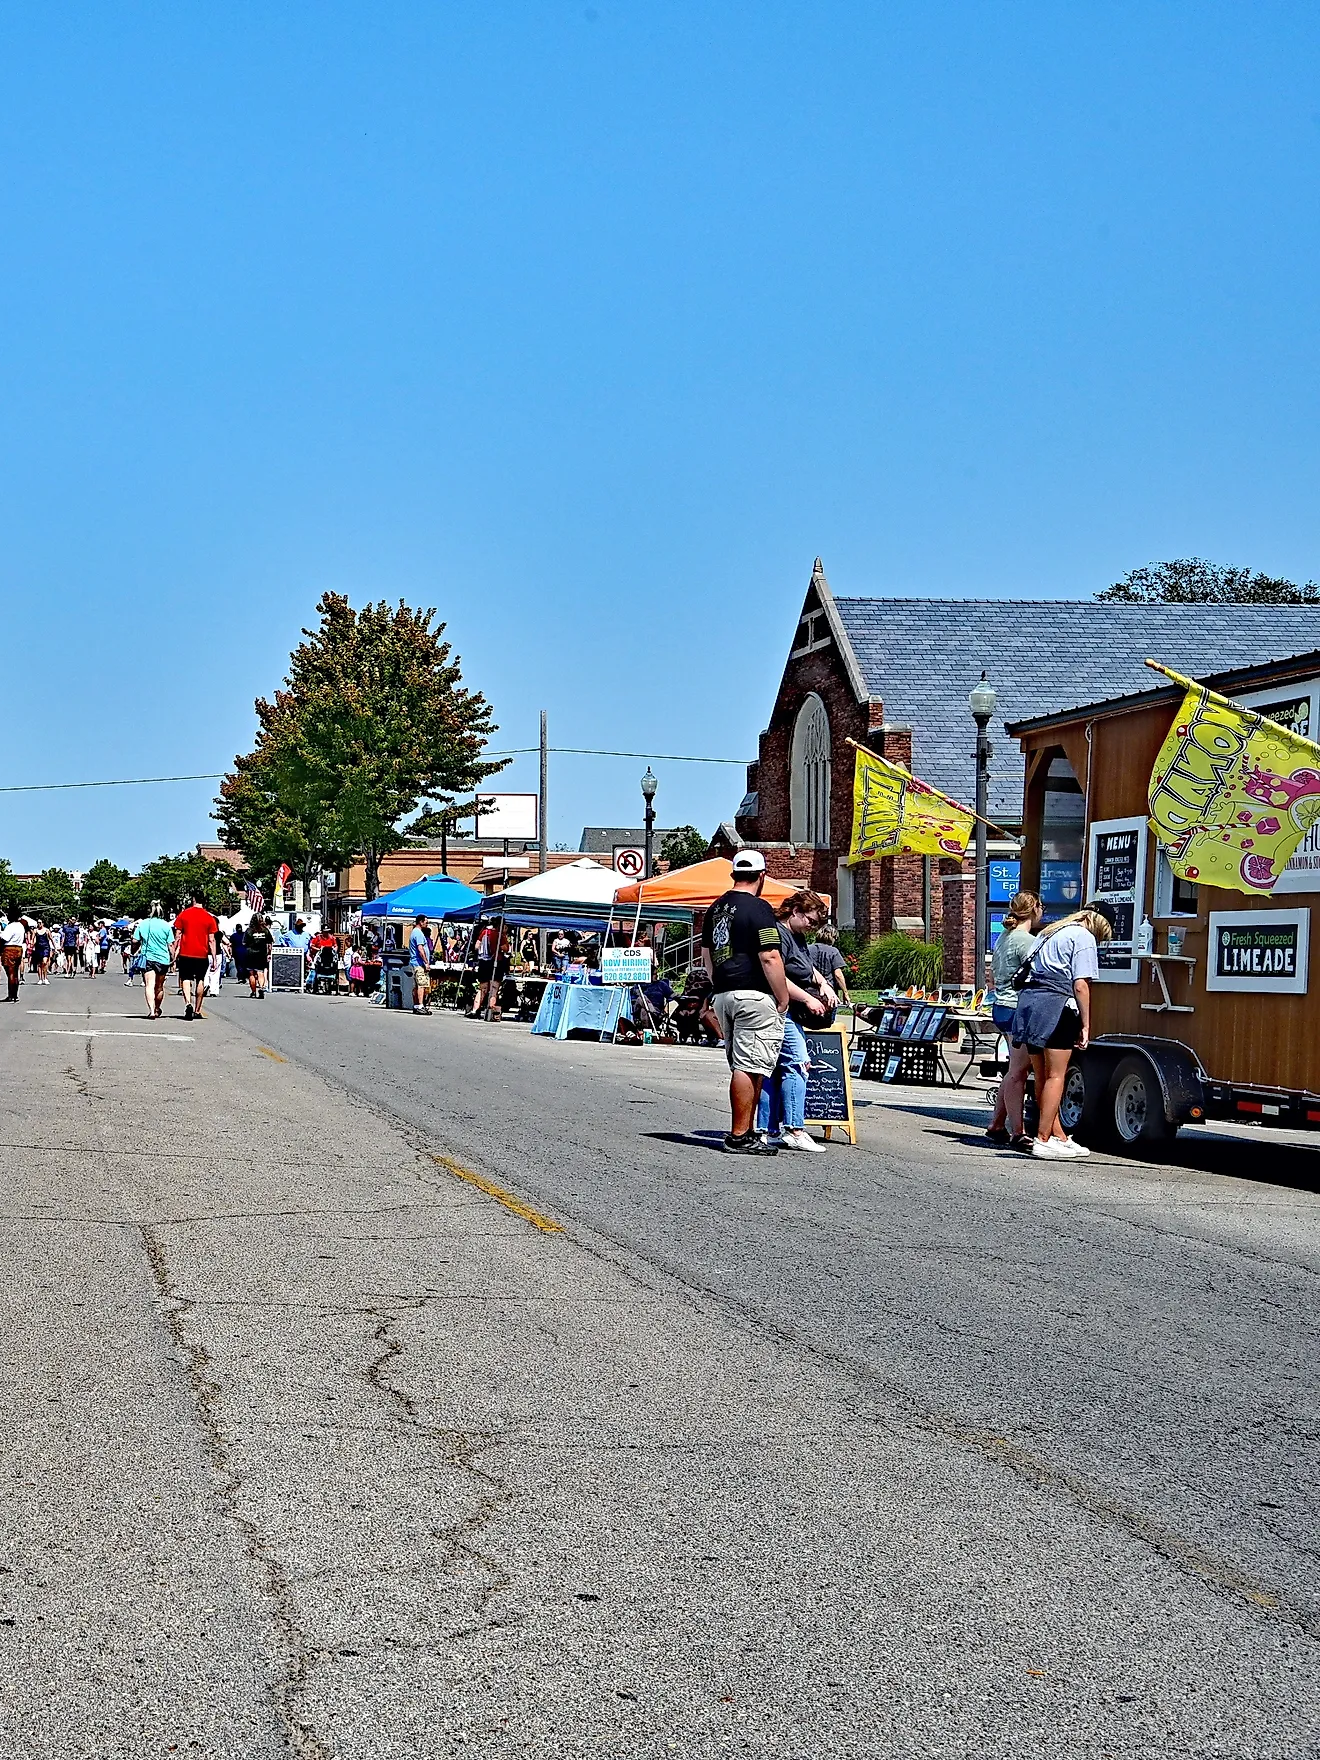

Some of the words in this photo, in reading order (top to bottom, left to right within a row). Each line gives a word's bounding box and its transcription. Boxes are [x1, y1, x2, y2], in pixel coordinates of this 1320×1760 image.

[1106, 835, 1131, 851] MENU
[991, 866, 1012, 878] St.
[1231, 932, 1252, 946] Fresh
[1254, 931, 1294, 947] Squeezed
[604, 959, 620, 967] NOW
[622, 959, 650, 967] HIRING!
[1223, 948, 1294, 972] LIMEADE
